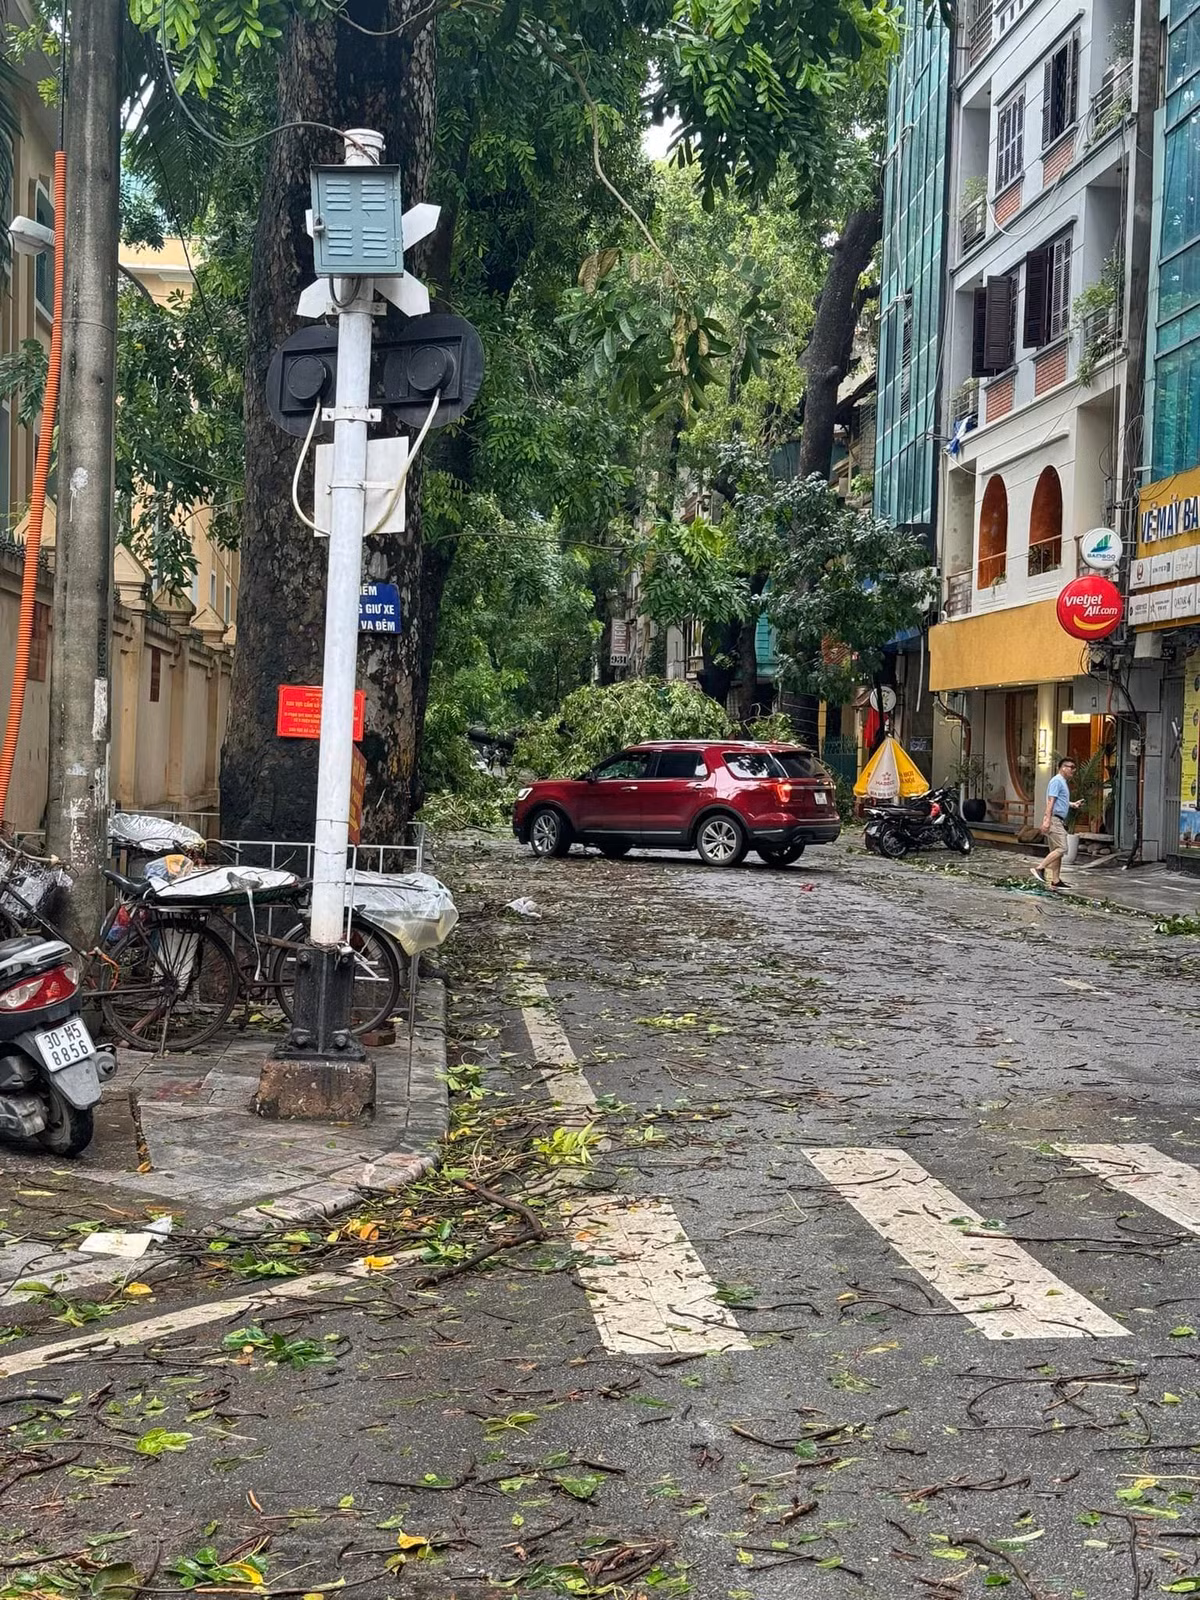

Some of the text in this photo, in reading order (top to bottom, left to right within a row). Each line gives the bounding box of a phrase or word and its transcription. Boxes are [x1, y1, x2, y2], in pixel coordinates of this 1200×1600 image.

[1183, 495, 1200, 531] BA
[383, 604, 395, 615] XE
[1083, 606, 1118, 617] Air.com
[375, 618, 396, 632] ĐÊM
[611, 655, 627, 665] 931
[51, 1040, 89, 1066] 8856
